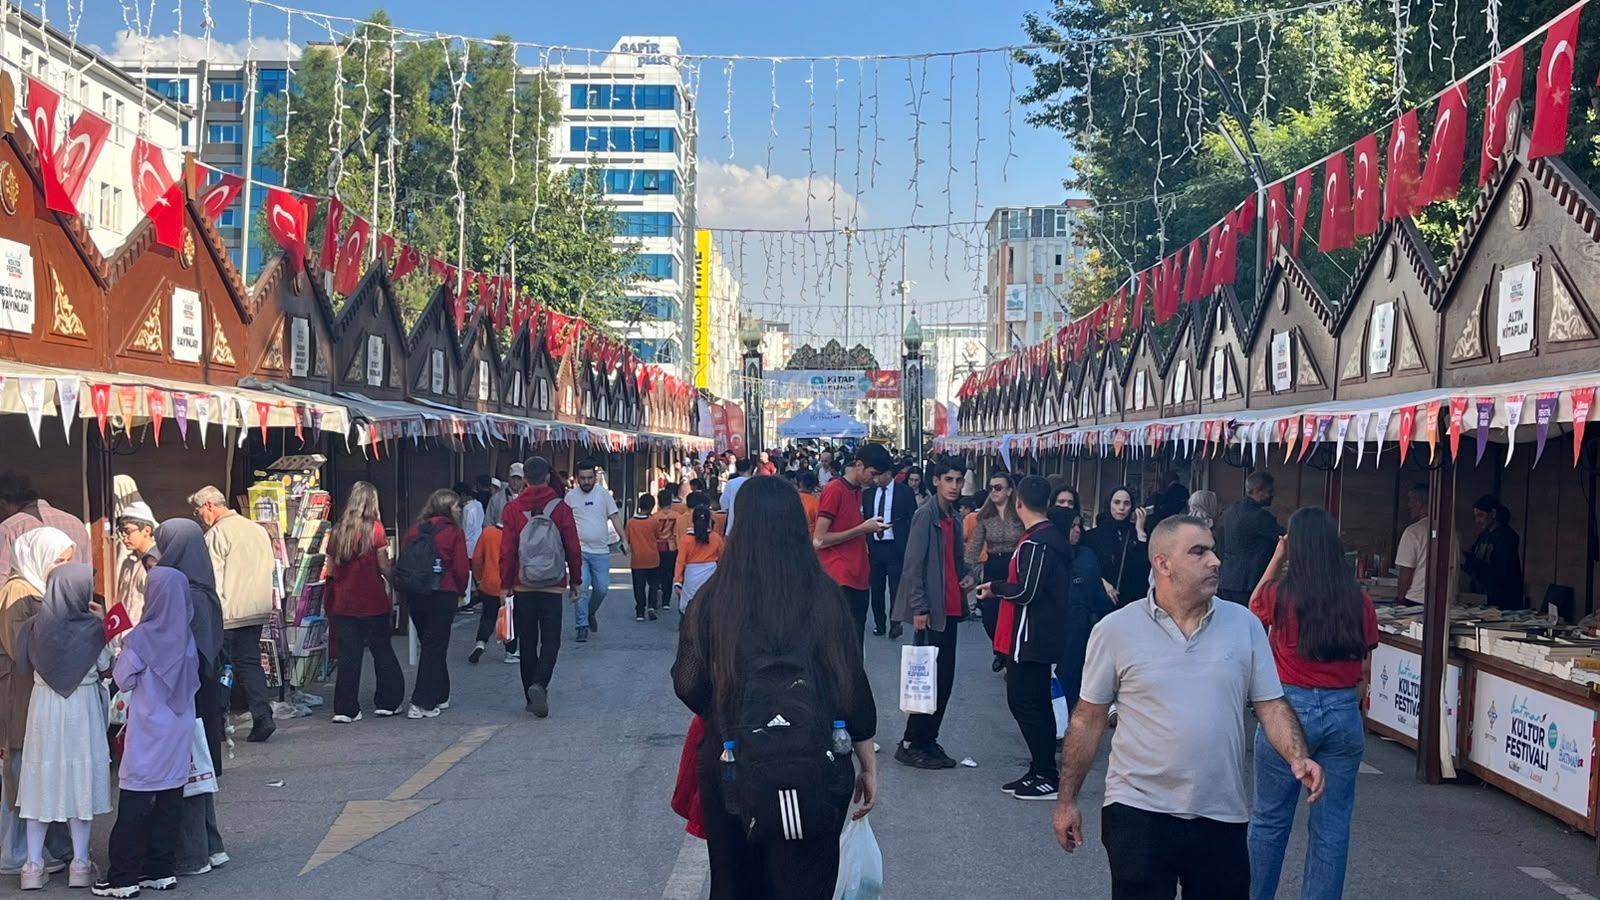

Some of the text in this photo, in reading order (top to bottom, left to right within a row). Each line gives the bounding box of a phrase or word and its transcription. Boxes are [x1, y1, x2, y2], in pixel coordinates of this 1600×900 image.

[14, 288, 32, 302] ÇOCUK
[2, 298, 29, 314] YAYINLARI
[1508, 309, 1523, 323] ALTIN
[1502, 322, 1528, 338] KİTAPLAR
[1399, 678, 1420, 699] KÜLTÜ
[1394, 693, 1420, 718] FESTİVA
[1511, 716, 1545, 748] KÜLTÜR
[1505, 735, 1549, 772] FESTİVALİ
